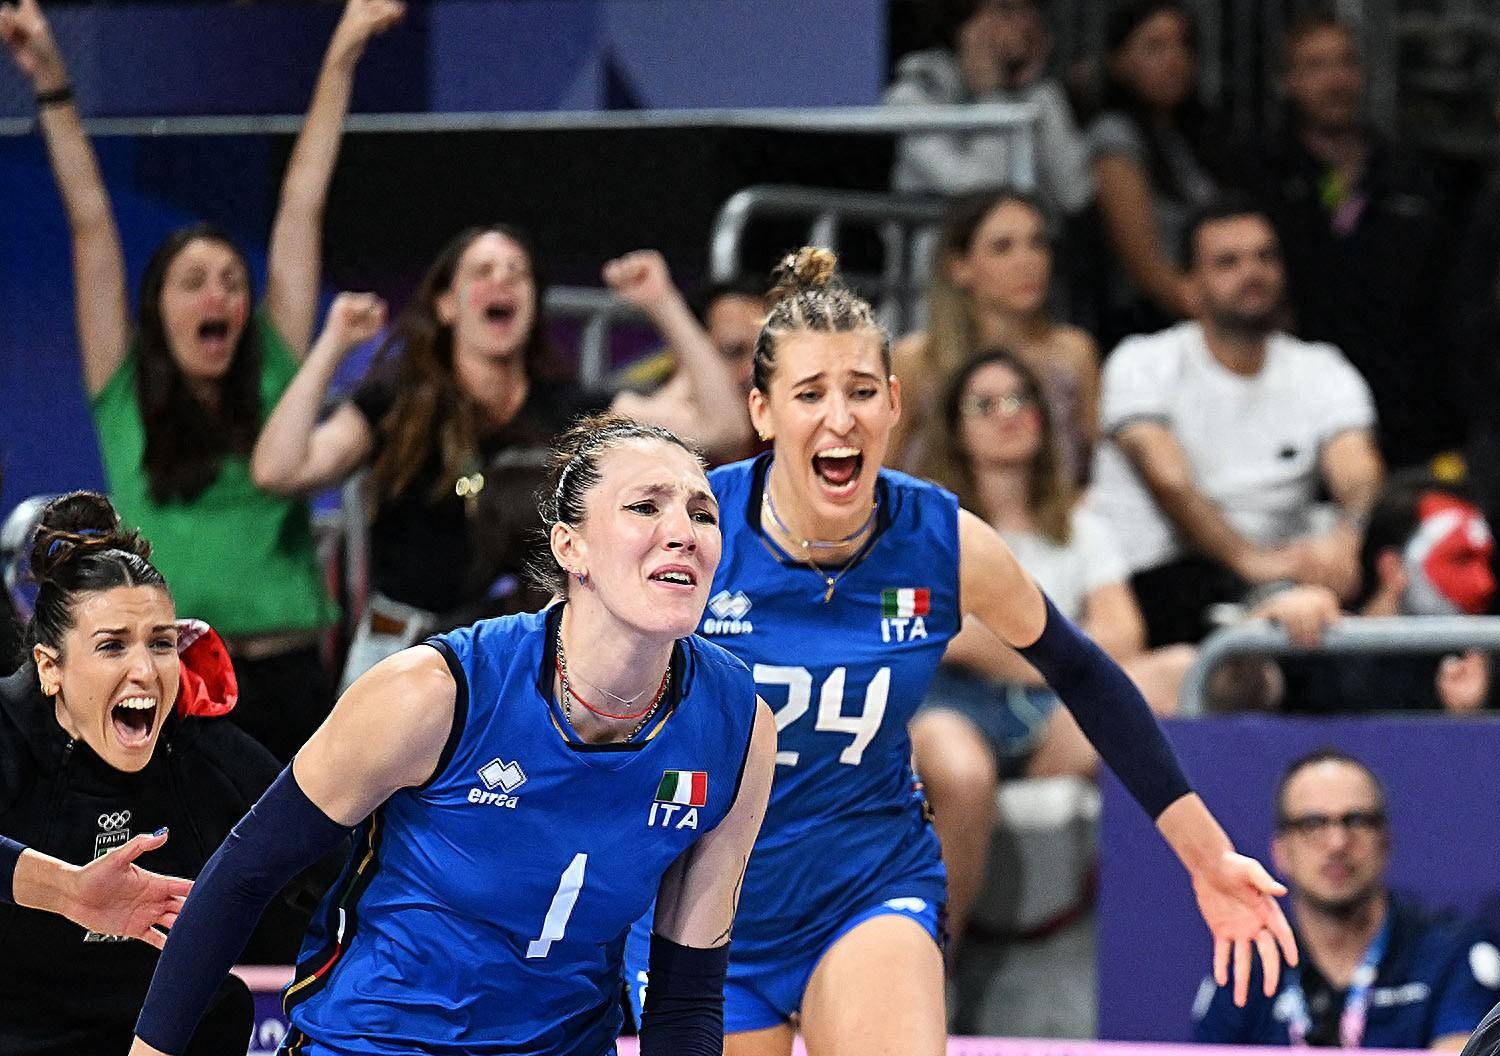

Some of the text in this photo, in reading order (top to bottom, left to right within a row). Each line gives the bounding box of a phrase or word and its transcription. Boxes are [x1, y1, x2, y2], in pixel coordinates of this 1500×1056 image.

[881, 617, 928, 643] ITA
[753, 664, 891, 766] 24
[468, 788, 519, 808] errea
[648, 803, 699, 830] ITA
[526, 853, 588, 958] 1
